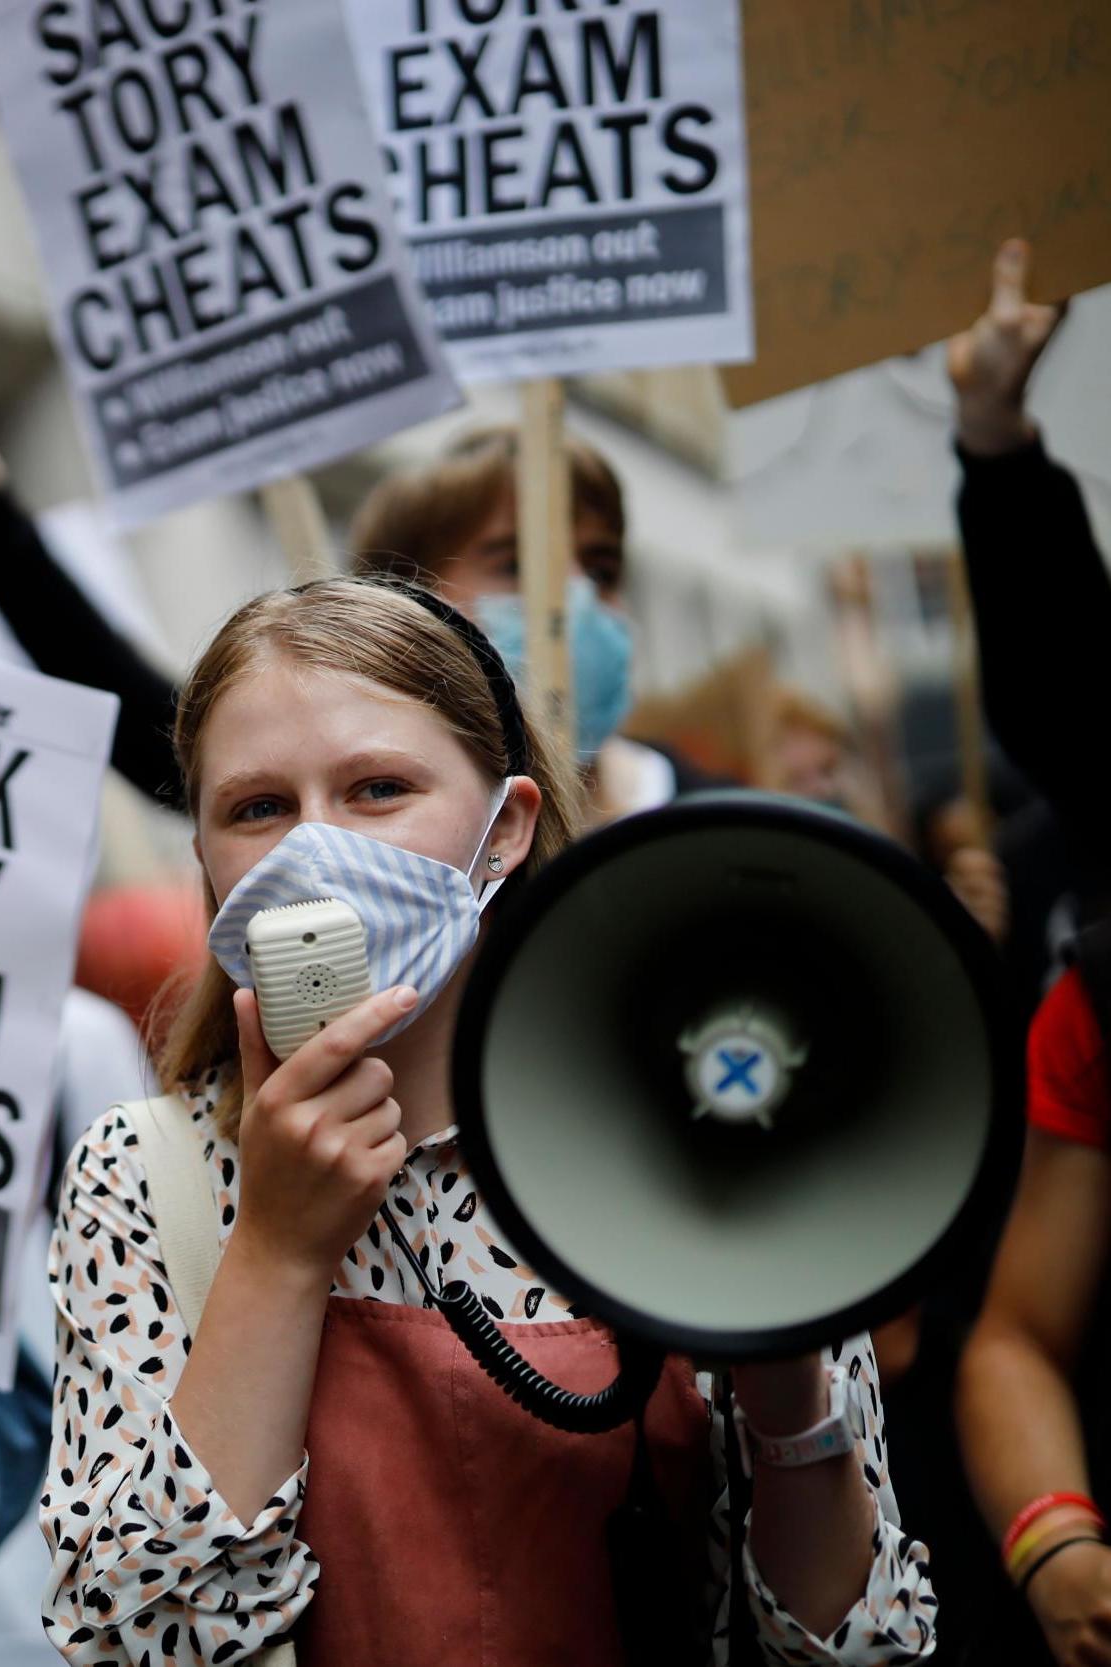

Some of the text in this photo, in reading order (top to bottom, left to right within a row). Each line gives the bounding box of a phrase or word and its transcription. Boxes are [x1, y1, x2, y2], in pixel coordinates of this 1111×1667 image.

[36, 0, 257, 86] SA
[59, 14, 257, 173] TORY
[389, 13, 663, 132] EXAM
[78, 102, 317, 271] EXAM
[383, 104, 720, 223] HEATS
[69, 183, 381, 372] CHEATS
[591, 220, 659, 264] out
[625, 268, 706, 306] now
